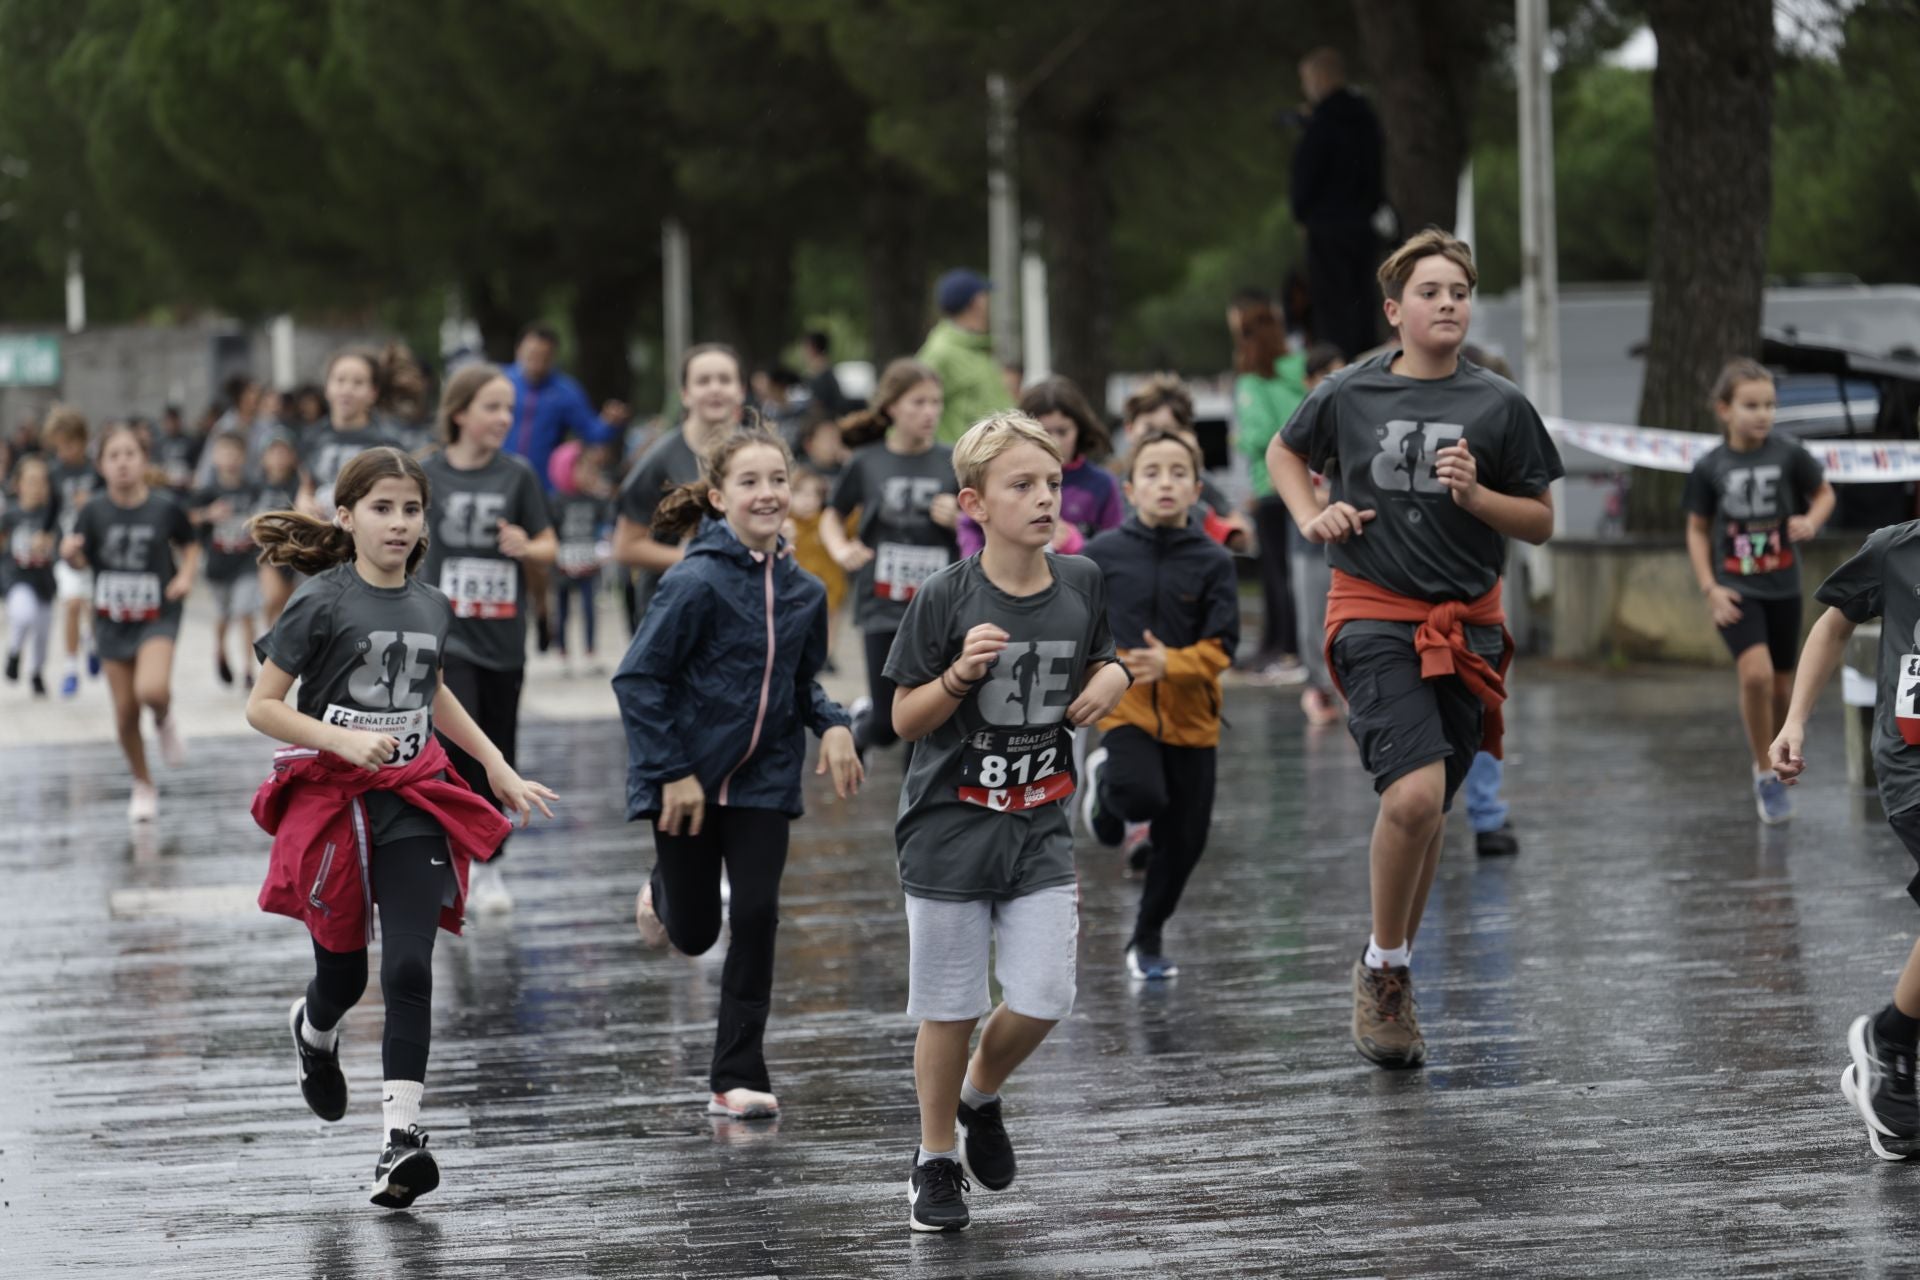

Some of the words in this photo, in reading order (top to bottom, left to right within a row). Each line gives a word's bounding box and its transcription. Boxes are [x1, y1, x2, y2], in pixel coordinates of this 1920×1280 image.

[353, 715, 384, 725] BEÑAT
[385, 716, 408, 725] ELZO
[1007, 734, 1040, 746] BEÑAT
[979, 747, 1057, 789] 812
